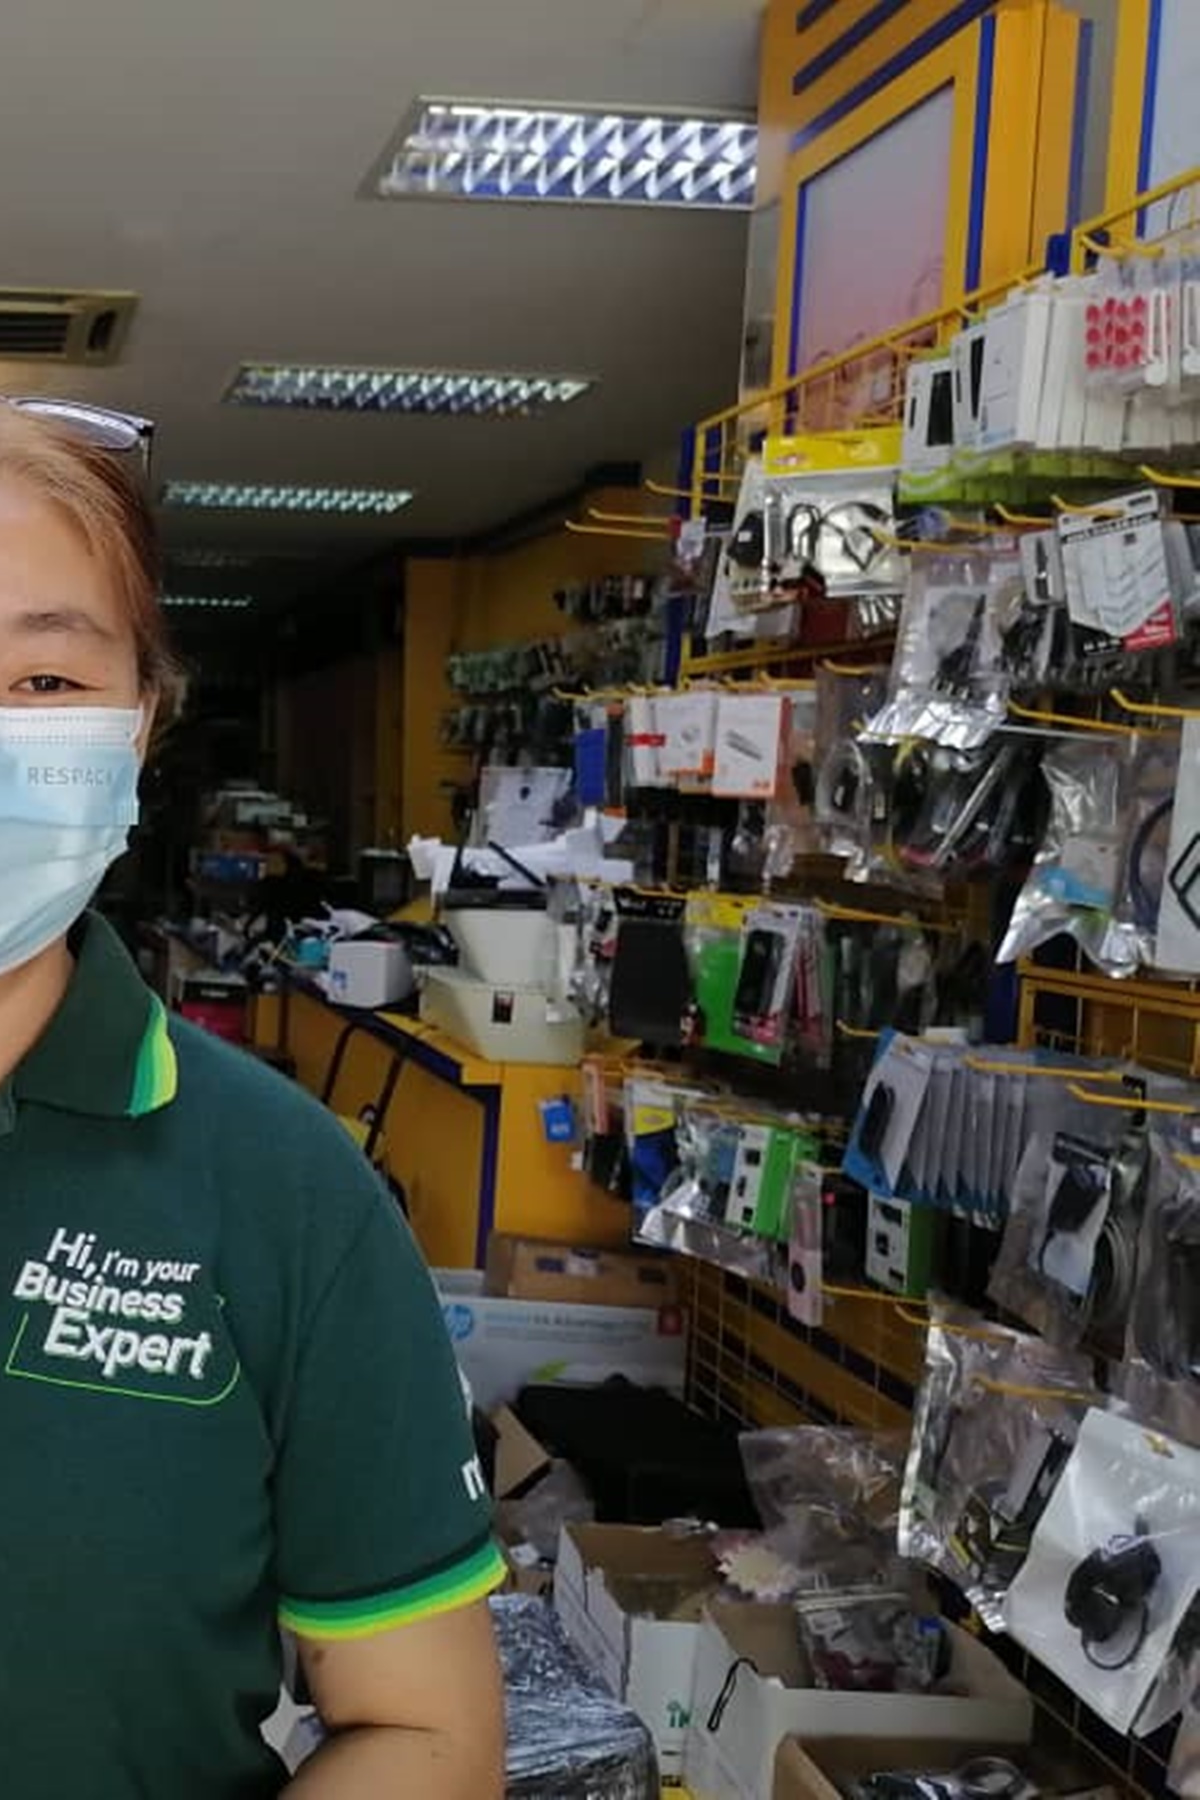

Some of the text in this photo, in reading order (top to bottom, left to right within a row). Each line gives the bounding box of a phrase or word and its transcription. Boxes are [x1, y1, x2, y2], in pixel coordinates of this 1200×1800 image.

[12, 1260, 186, 1325] Business
[142, 1259, 201, 1286] your
[43, 1305, 212, 1380] Expert
